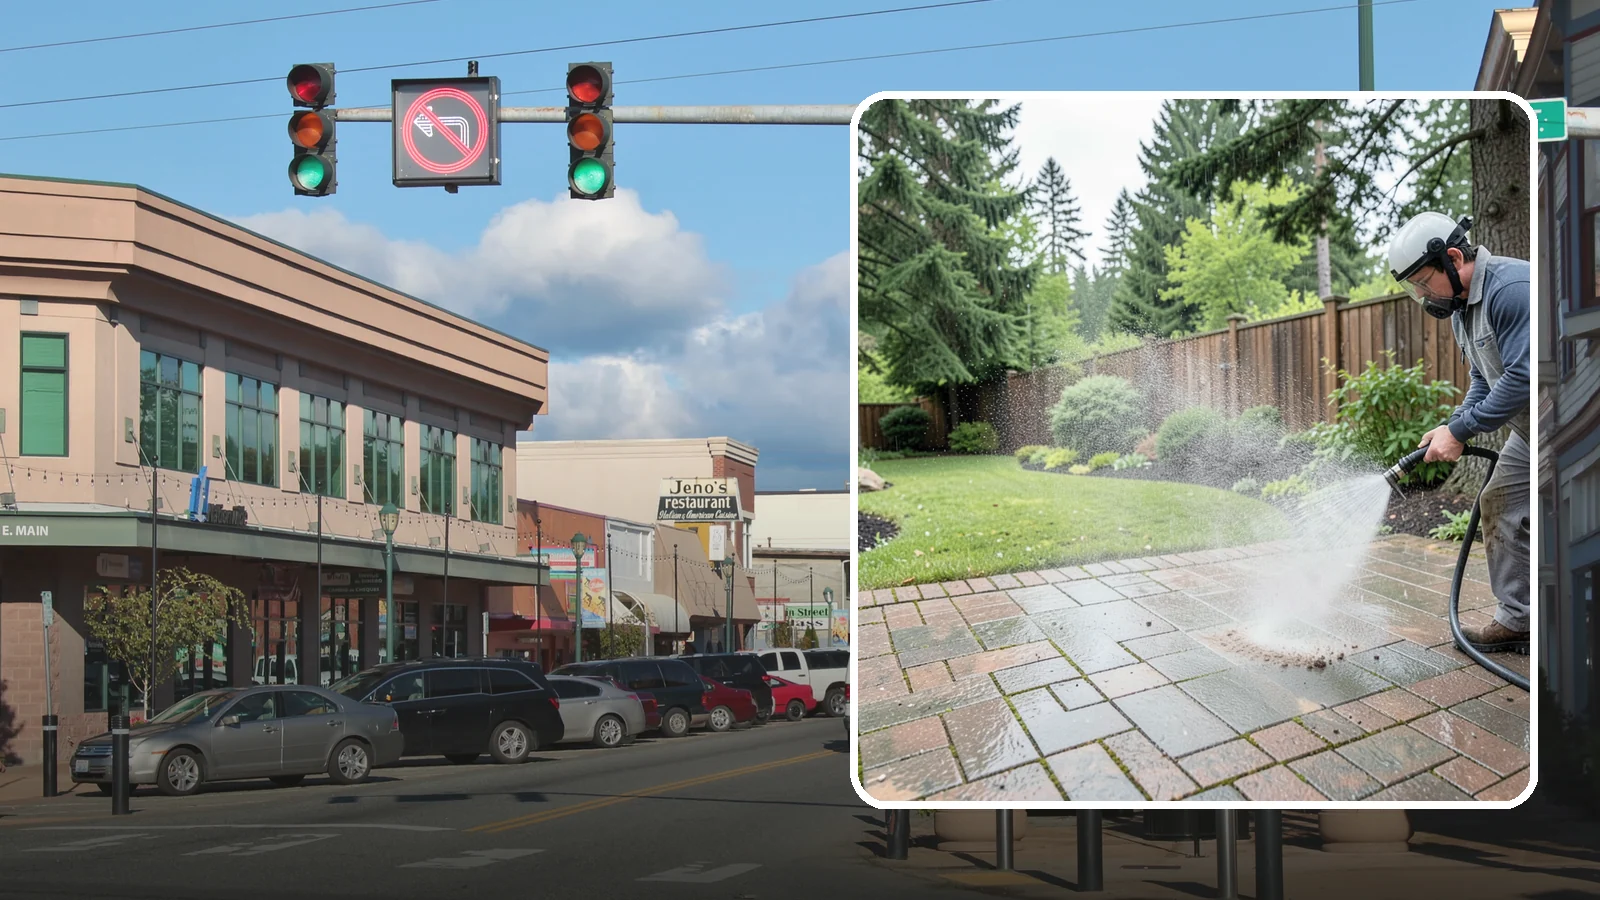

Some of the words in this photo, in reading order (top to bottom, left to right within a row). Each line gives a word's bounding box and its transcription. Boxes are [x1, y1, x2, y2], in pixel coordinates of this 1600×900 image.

[670, 480, 727, 494] Jeno's
[665, 496, 731, 509] restaurant
[659, 510, 681, 519] Italian
[686, 509, 714, 519] American
[715, 509, 738, 519] Cuisine
[2, 525, 13, 536] E.
[15, 525, 49, 536] MAIN
[797, 608, 828, 617] Street
